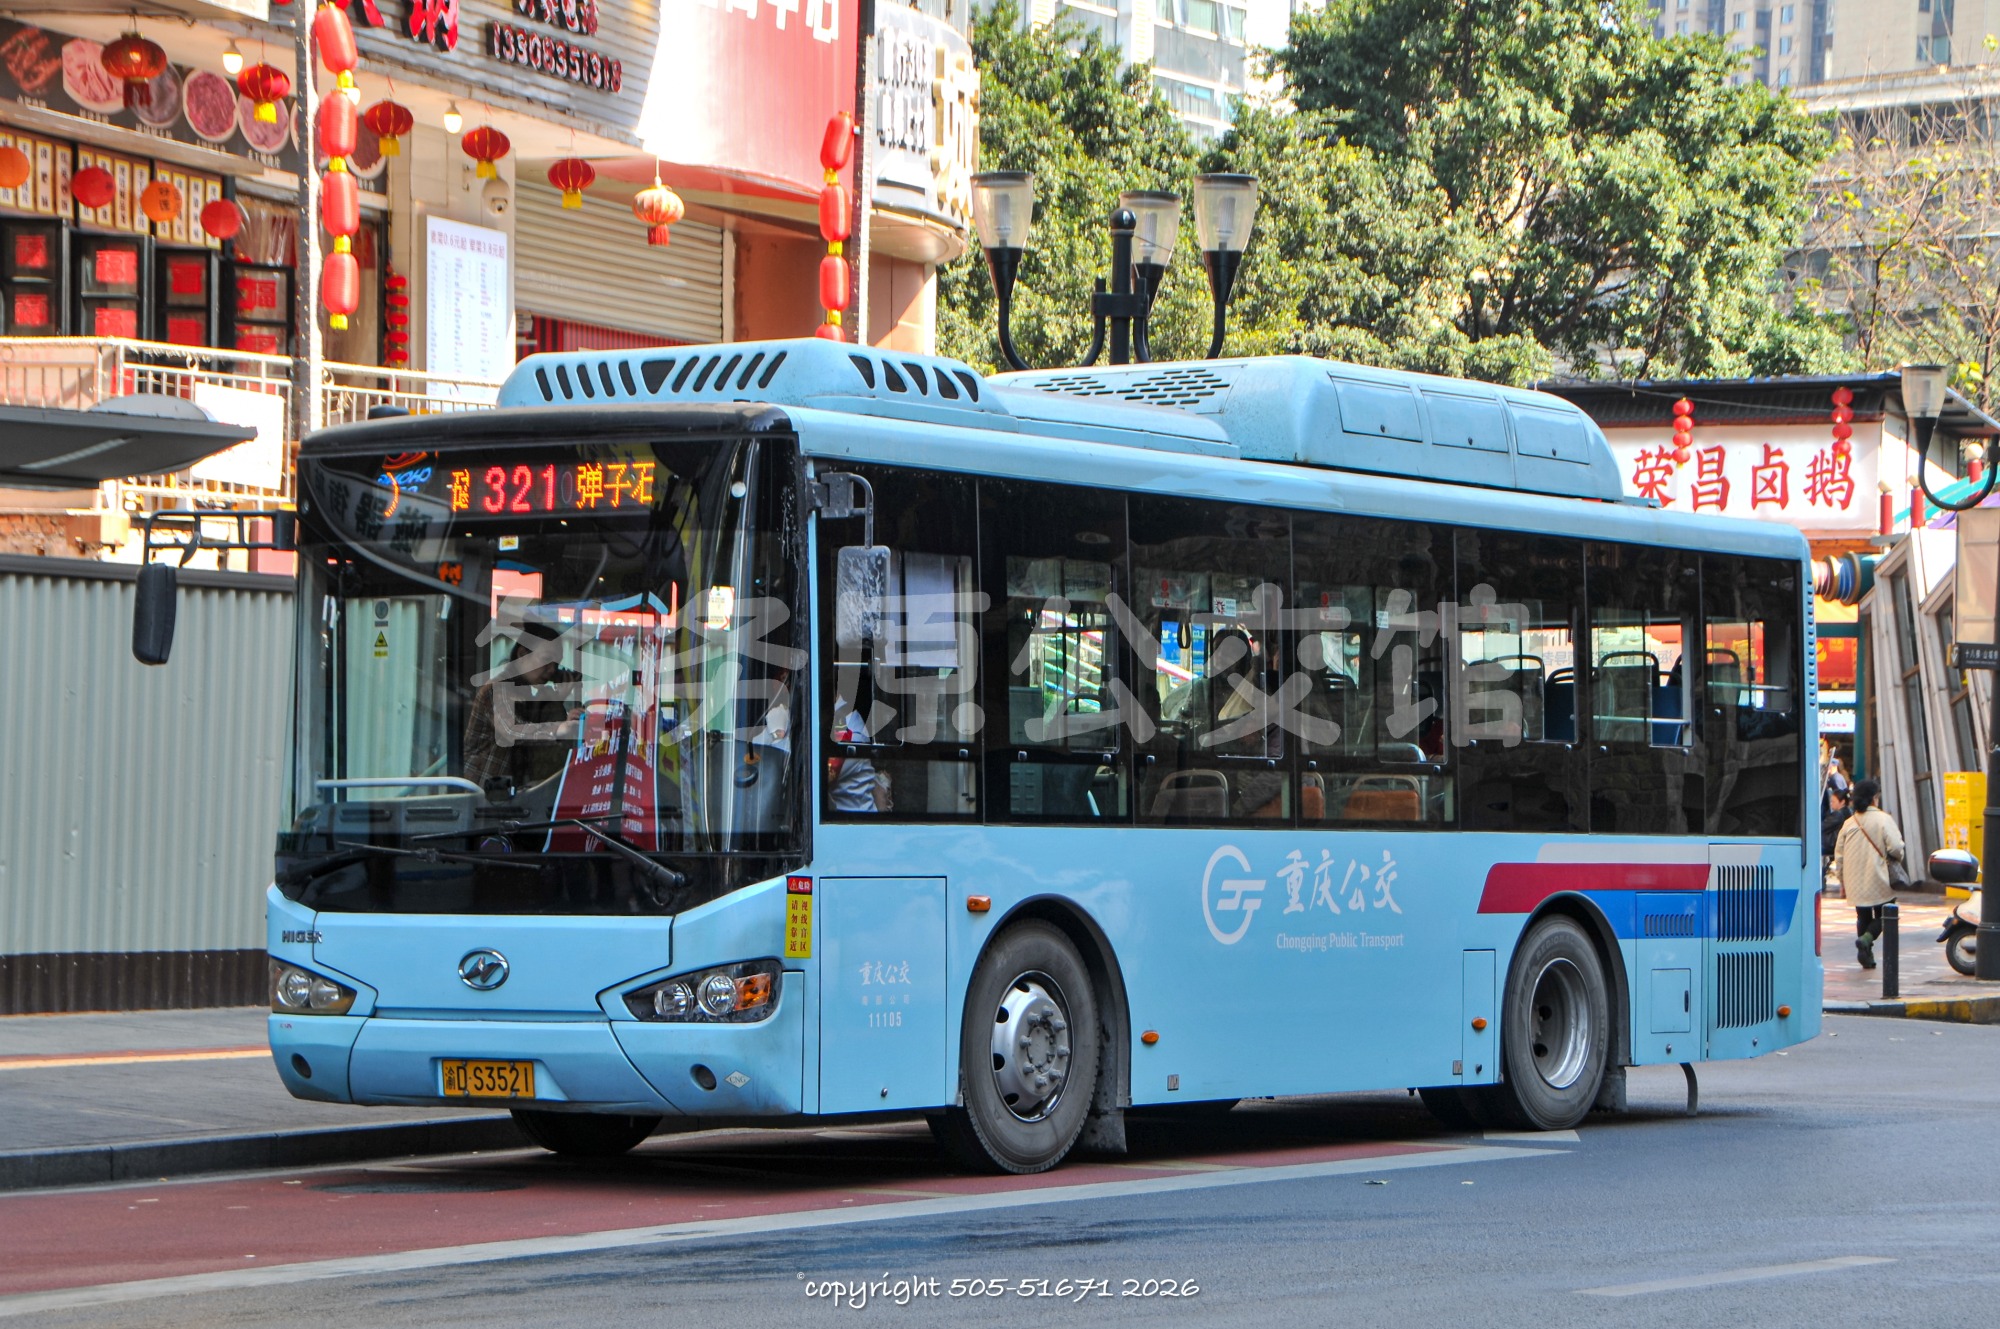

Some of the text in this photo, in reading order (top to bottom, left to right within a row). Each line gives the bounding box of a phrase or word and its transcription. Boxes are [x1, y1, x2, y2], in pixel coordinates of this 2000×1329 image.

[483, 464, 556, 513] 321
[1632, 442, 1856, 511] 荣昌卤鹅
[1276, 849, 1403, 915] 重庆公交
[281, 930, 322, 944] HIGER
[1276, 932, 1404, 952] Chongqing Public Transport
[858, 960, 912, 986] 重庆公交
[868, 1011, 903, 1028] 11105
